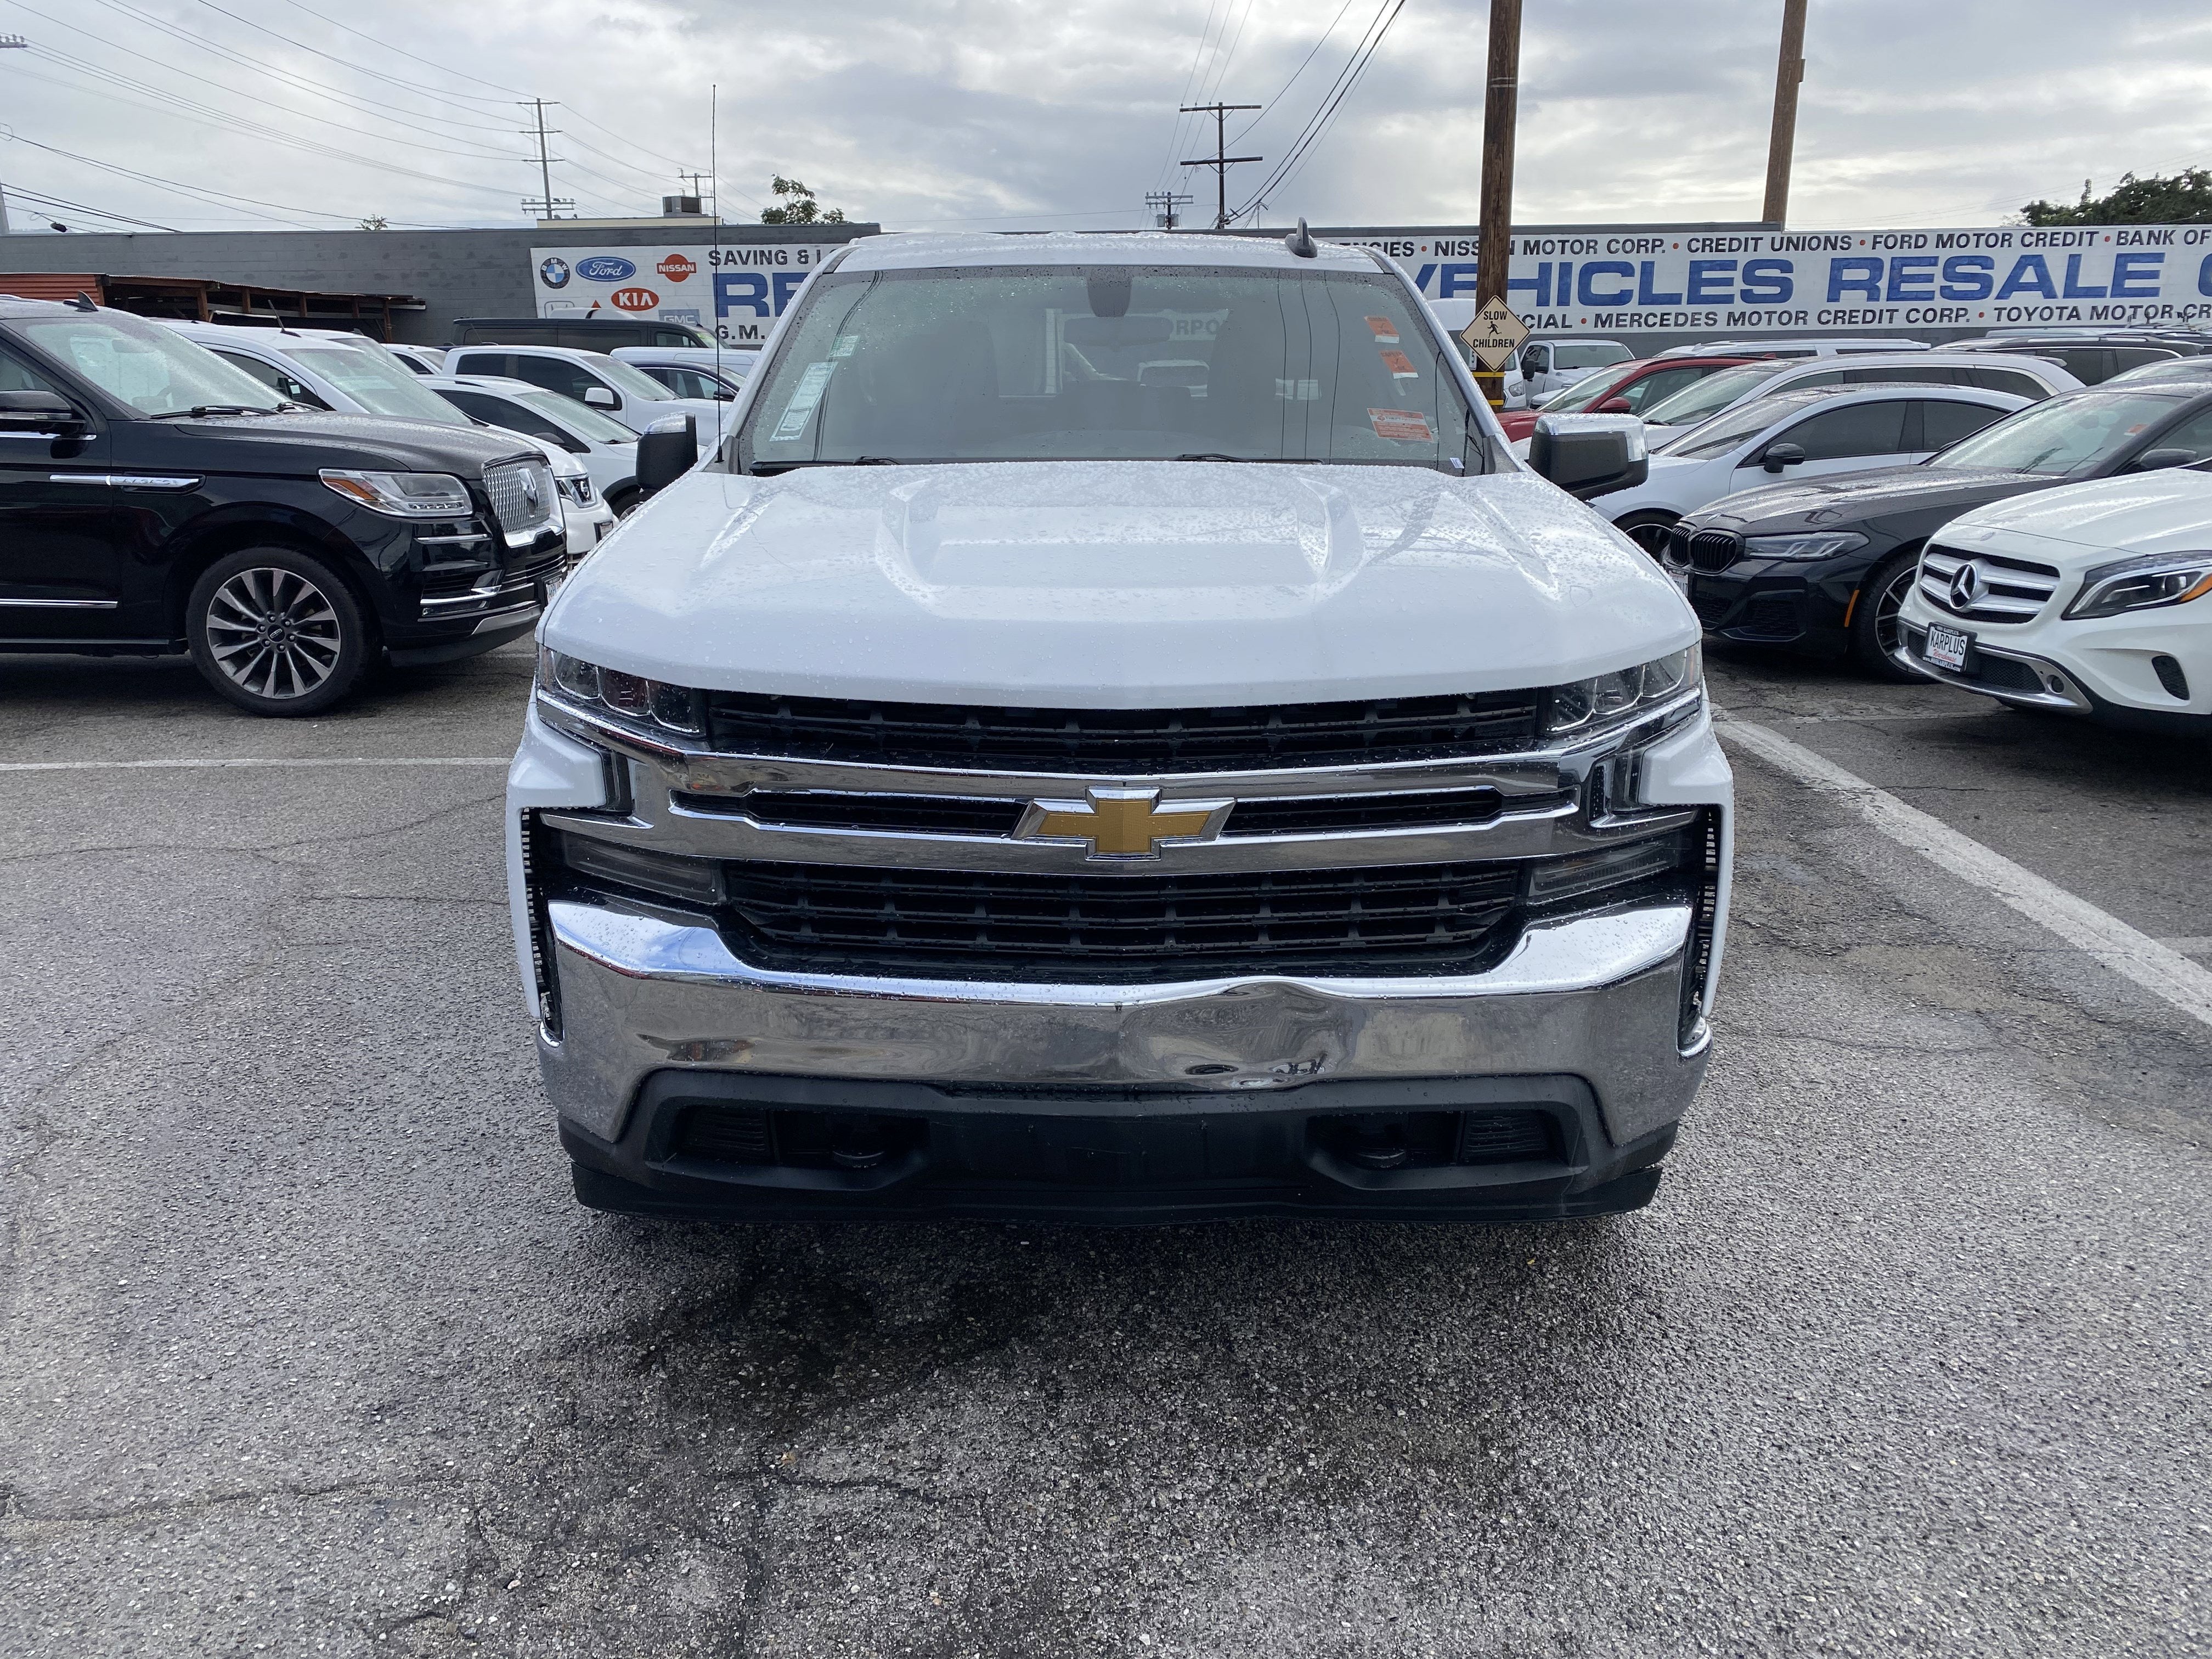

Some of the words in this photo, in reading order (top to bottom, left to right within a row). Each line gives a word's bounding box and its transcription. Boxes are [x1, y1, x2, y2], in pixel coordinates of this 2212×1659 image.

[1523, 239, 1598, 255] MOTOR
[1607, 238, 1666, 254] CORP.
[1687, 236, 1763, 253] CREDIT
[1771, 235, 1852, 252] UNIONS
[1872, 233, 1928, 250] FORD
[1936, 232, 2013, 249] MOTOR
[2021, 231, 2099, 247] CREDIT
[2116, 229, 2176, 246] BANK
[2184, 229, 2211, 245] OF
[708, 250, 788, 266] SAVING
[797, 249, 809, 264] &
[589, 262, 623, 276] Ford
[659, 264, 695, 272] NISSAN
[1827, 252, 2166, 302] RESALE
[618, 292, 653, 306] KIA
[664, 315, 696, 323] GMC
[1483, 311, 1507, 320] SLOW
[1594, 311, 1718, 328] MERCEDES
[1726, 309, 1808, 326] MOTOR
[1818, 308, 1899, 325] CREDIT
[1906, 307, 1970, 324] CORP.
[1994, 306, 2083, 322] TOYOTA
[2090, 304, 2174, 320] MOTOR
[1473, 338, 1515, 348] CHILDREN
[1931, 630, 1965, 655] KARPLUS
